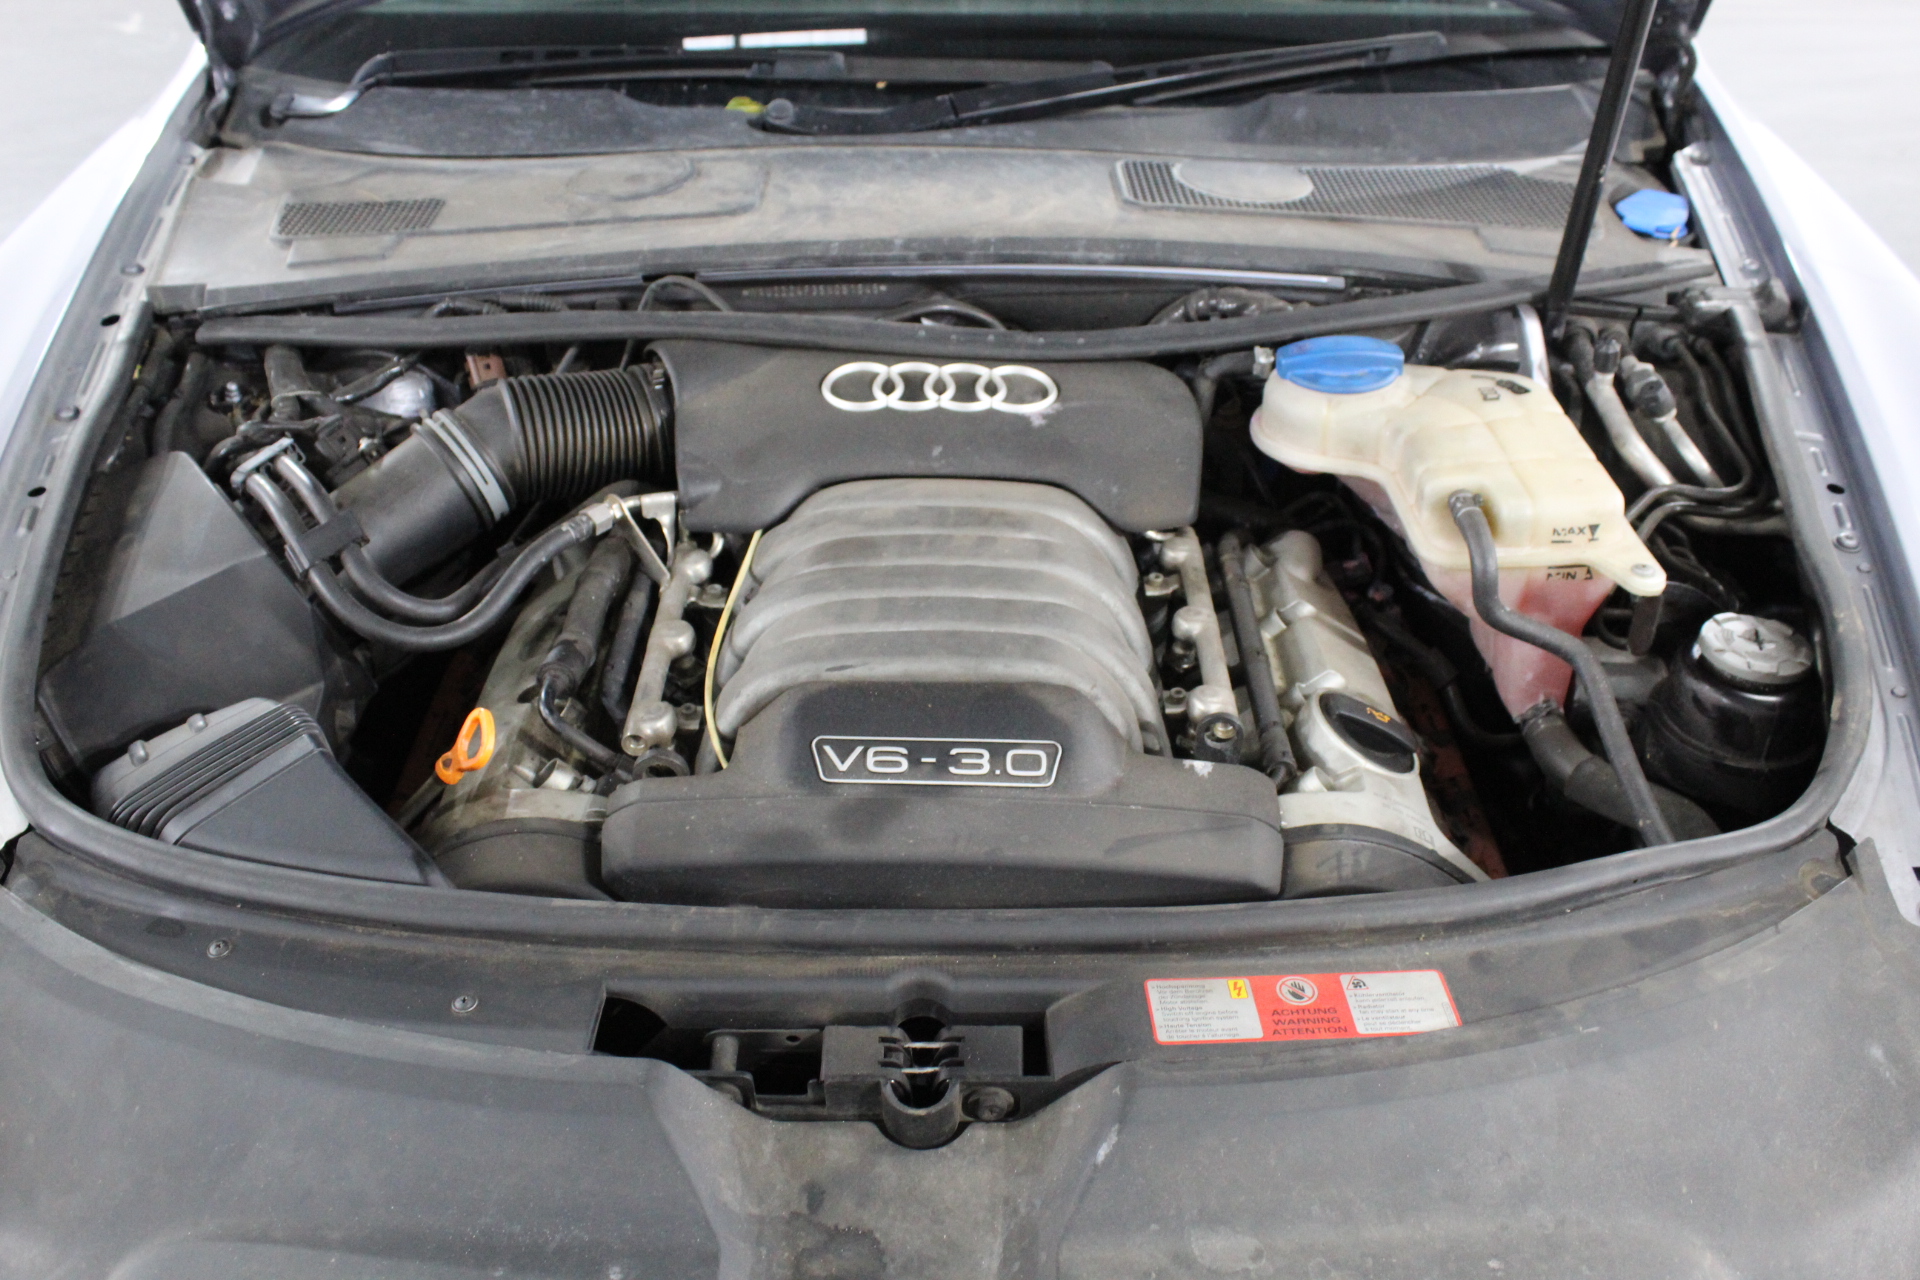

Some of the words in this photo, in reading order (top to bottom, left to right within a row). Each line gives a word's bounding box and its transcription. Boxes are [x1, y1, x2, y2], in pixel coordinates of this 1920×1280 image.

[823, 744, 908, 774] V6
[948, 747, 1047, 777] 3.0
[1272, 1007, 1338, 1016] ACHTUNG
[1272, 1016, 1341, 1026] WARNING
[1272, 1026, 1348, 1036] ATTENTION
